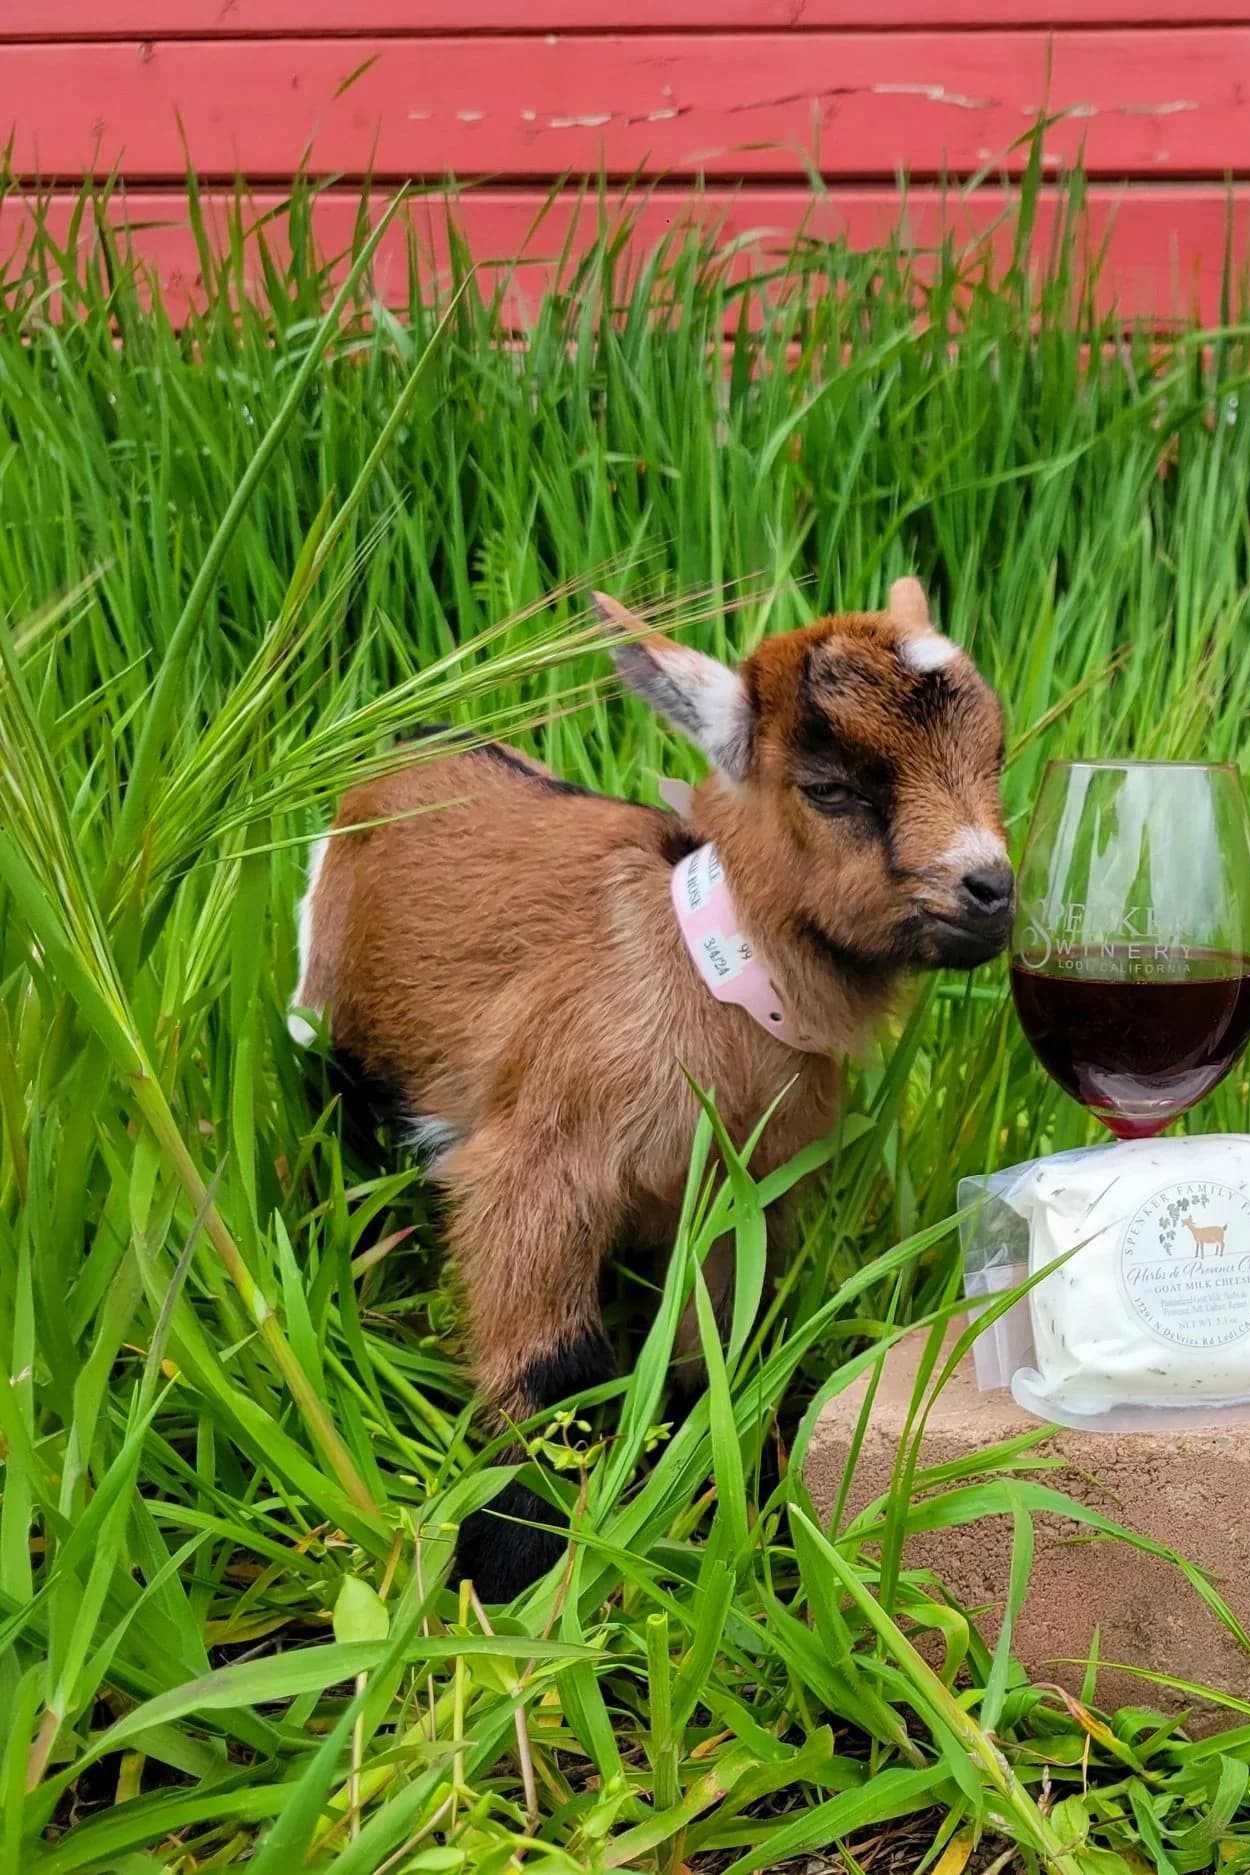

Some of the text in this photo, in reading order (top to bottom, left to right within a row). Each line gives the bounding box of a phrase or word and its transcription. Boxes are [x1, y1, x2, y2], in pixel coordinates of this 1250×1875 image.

[704, 937, 731, 976] 3/4/24
[1056, 939, 1192, 960] WINERY
[1101, 962, 1191, 974] CALIFORNIA
[1125, 1193, 1170, 1256] SPENKER
[1177, 1184, 1233, 1200] FAMILY
[1126, 1266, 1166, 1286] Herbs
[1154, 1276, 1250, 1294] GOAT MILK CHEESE
[1217, 1330, 1239, 1345] Lodi
